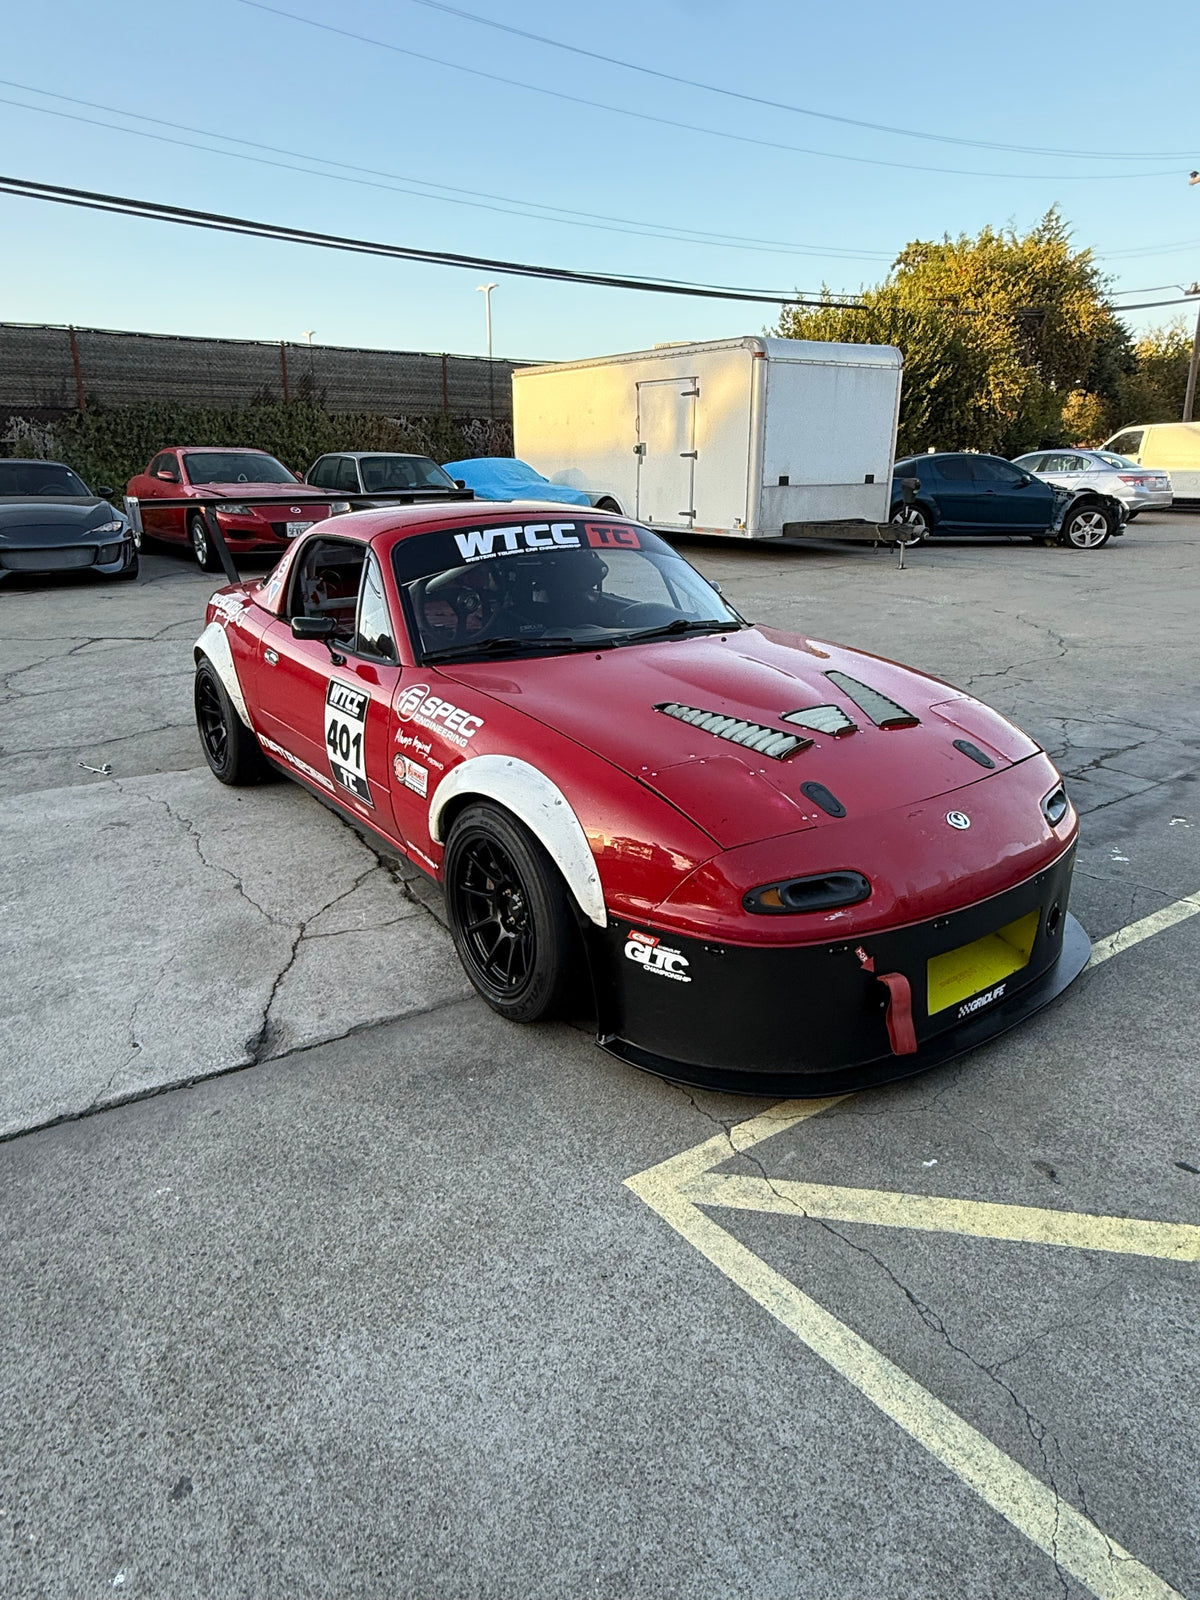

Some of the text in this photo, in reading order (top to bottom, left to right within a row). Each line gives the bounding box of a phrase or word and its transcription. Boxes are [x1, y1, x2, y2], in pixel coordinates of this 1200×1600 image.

[454, 523, 634, 559] WTCC TC
[465, 553, 497, 563] WESTERN
[329, 683, 365, 714] WTCC
[327, 719, 363, 770] 401
[413, 713, 469, 748] ENGINEERING
[340, 767, 358, 793] TC
[624, 940, 690, 976] GLTC
[643, 964, 692, 983] CHAMPIONSHIP
[970, 983, 1007, 1011] GRIDLIFE
